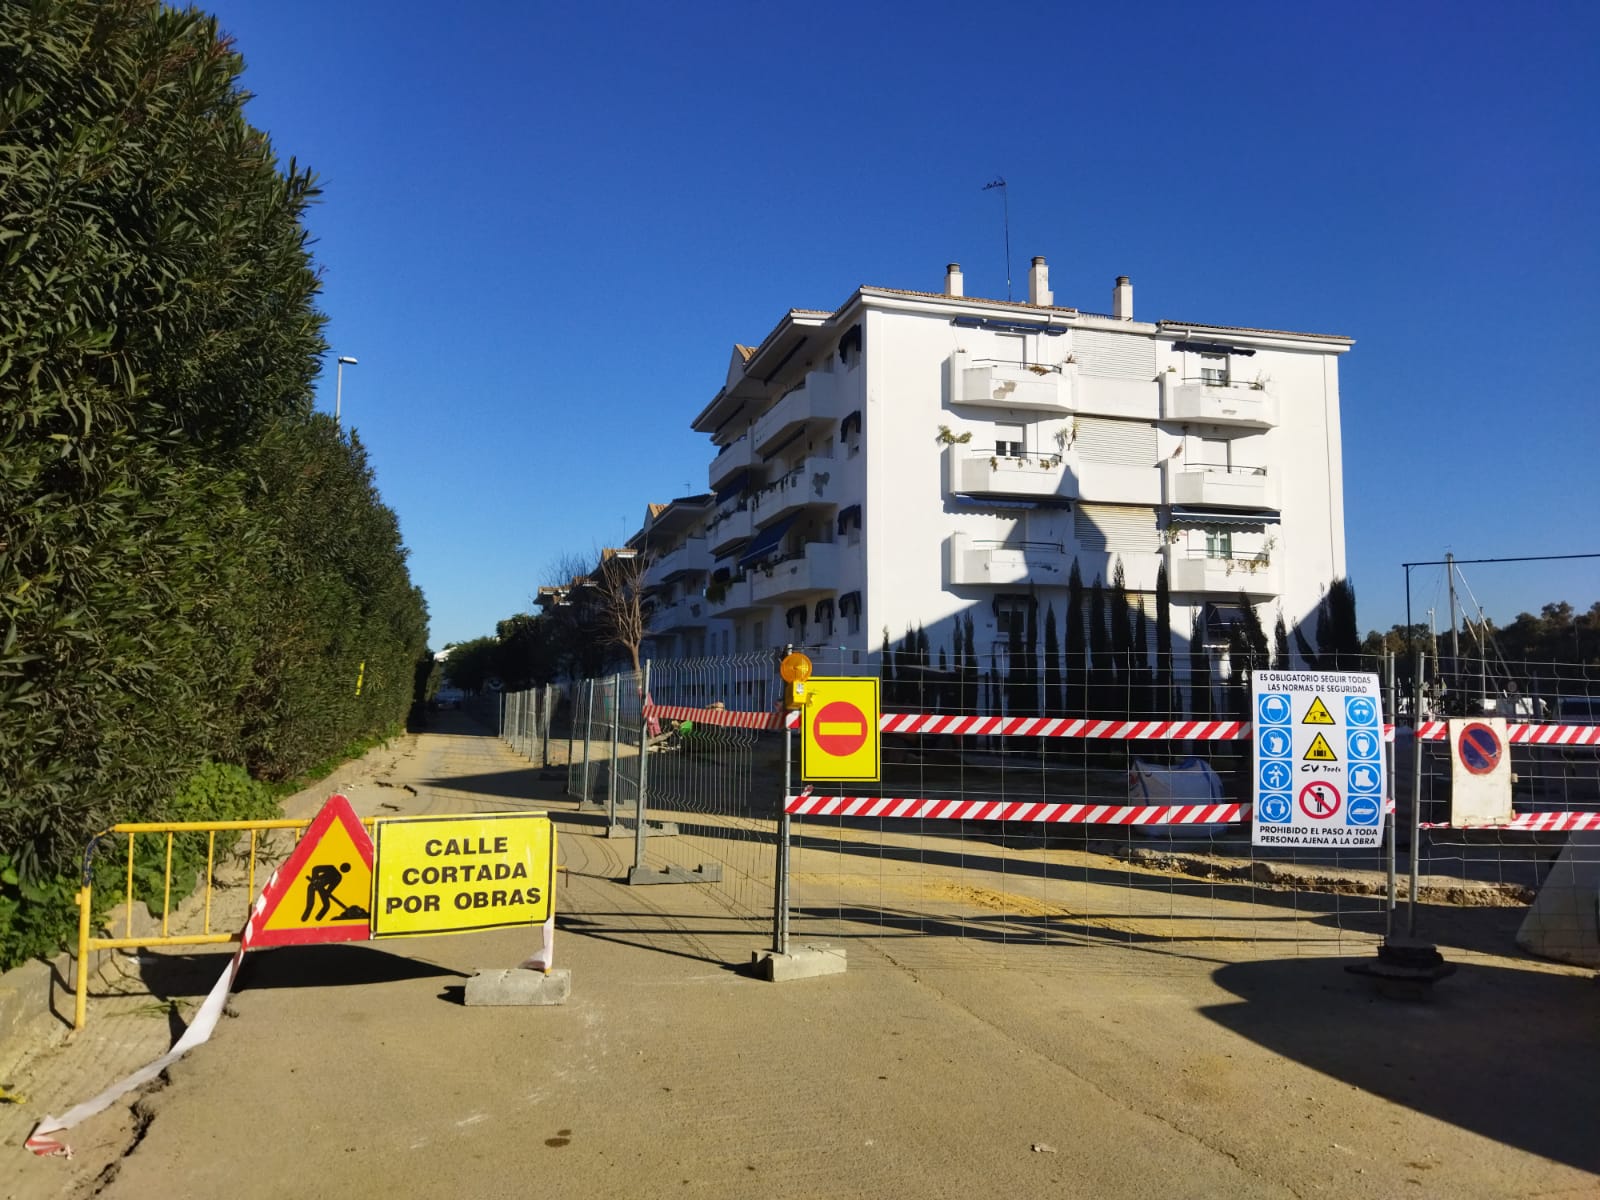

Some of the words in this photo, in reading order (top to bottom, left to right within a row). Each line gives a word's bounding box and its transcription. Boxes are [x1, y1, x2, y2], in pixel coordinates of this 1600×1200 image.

[1270, 674, 1318, 682] OBLIGATORIO
[1327, 685, 1367, 693] SEGURIDAD
[1260, 826, 1308, 834] PROHIBIDO
[425, 837, 508, 856] CALLE
[402, 862, 527, 885] CORTADA
[386, 895, 440, 914] POR
[454, 888, 541, 910] OBRAS
